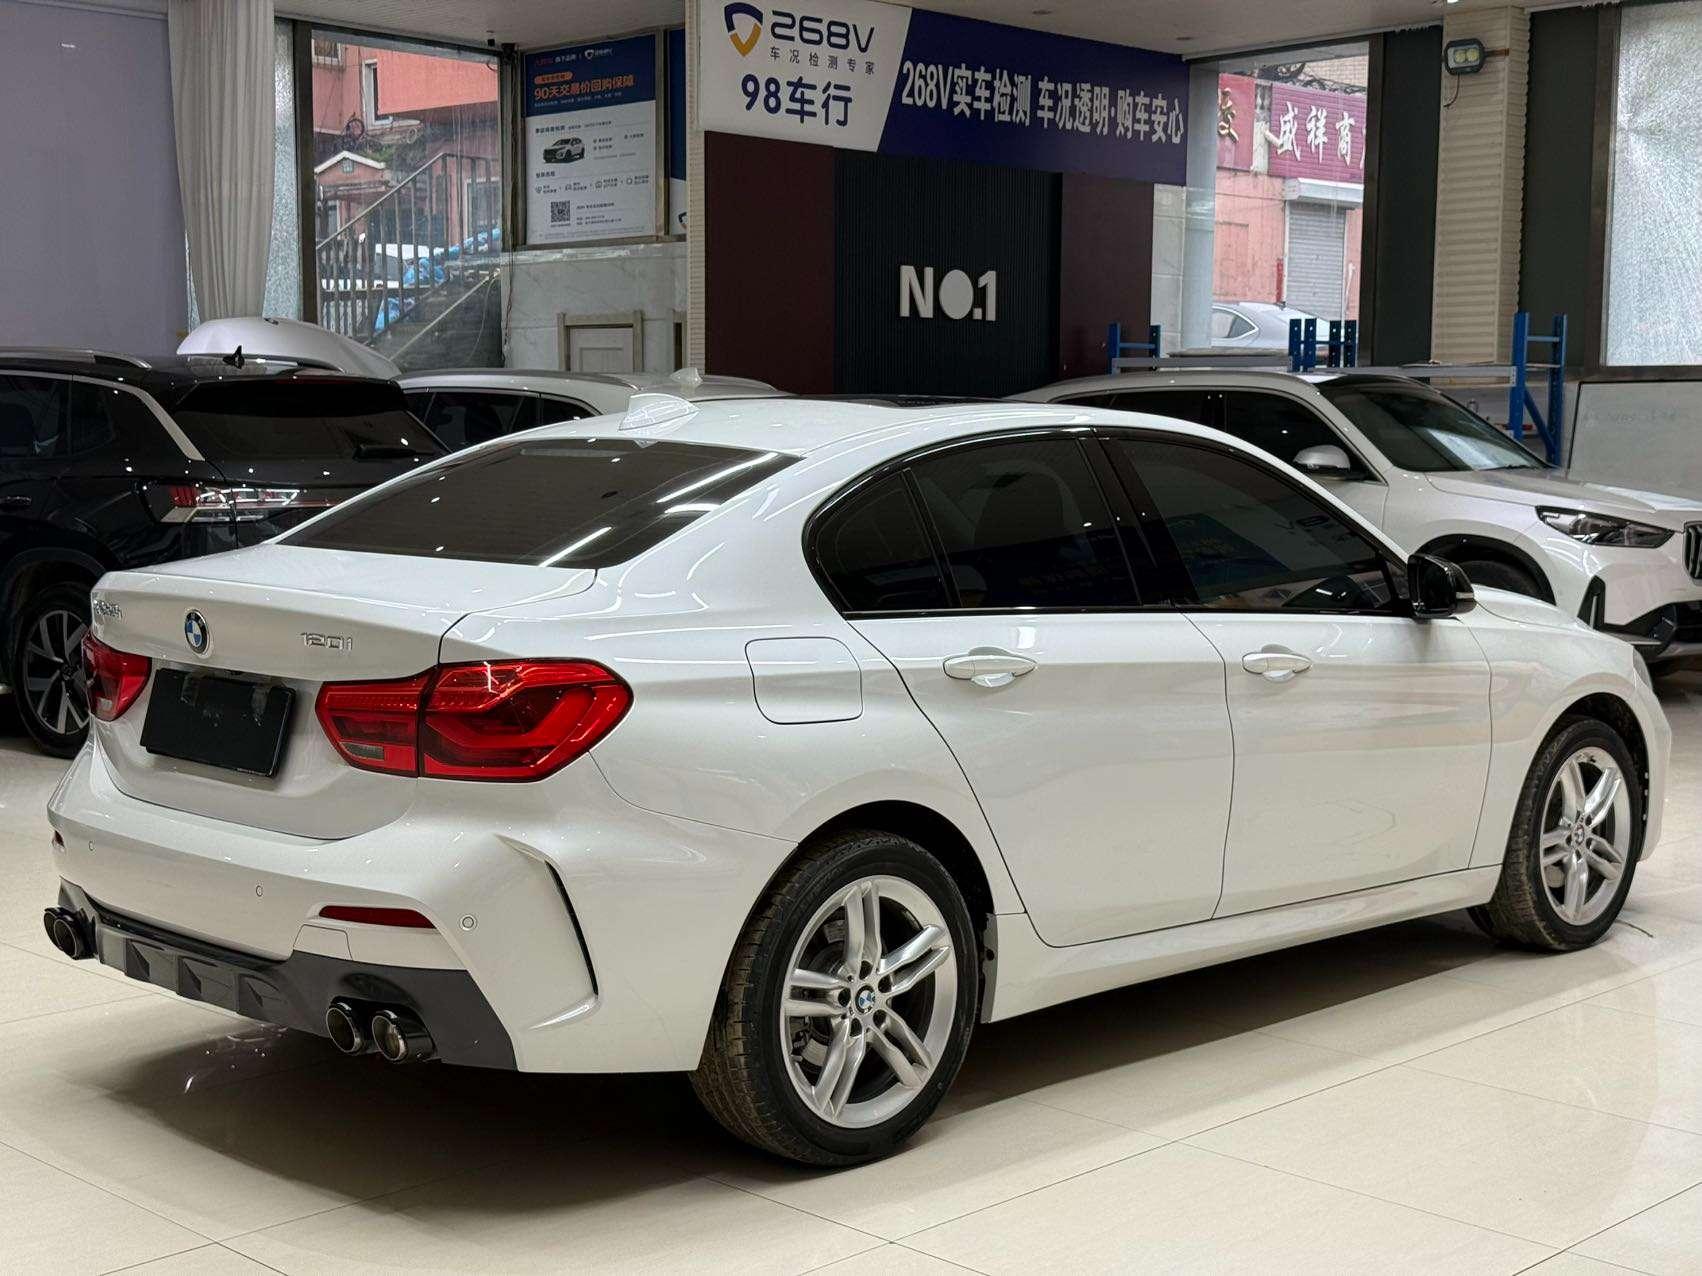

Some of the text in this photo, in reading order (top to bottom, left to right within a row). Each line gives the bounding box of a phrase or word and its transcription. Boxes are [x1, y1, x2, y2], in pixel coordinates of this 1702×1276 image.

[771, 10, 875, 53] 268V
[770, 46, 875, 75] 车况检测专家
[741, 73, 853, 126] 98车行
[901, 60, 1032, 126] 268V实车检测
[1037, 75, 1185, 144] 车况透明·购车安心
[900, 265, 996, 321] NO.1
[300, 632, 353, 651] 120i
